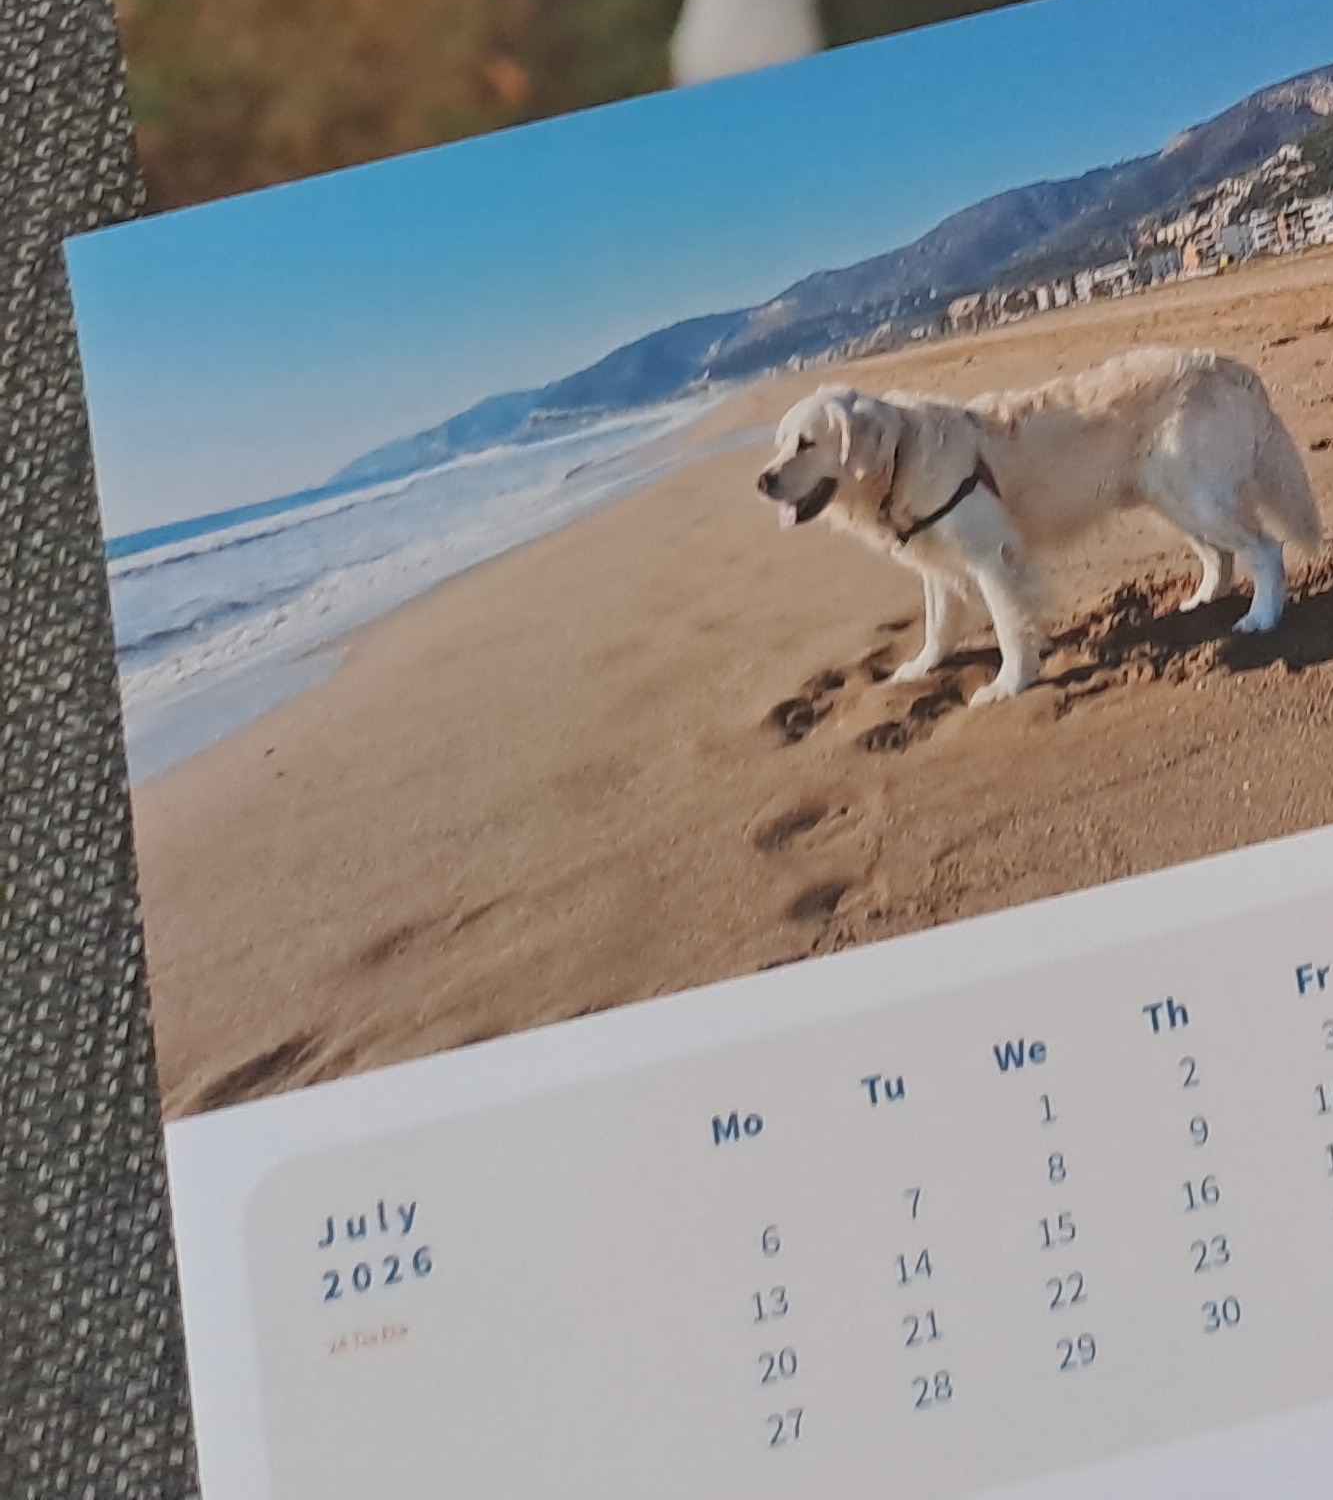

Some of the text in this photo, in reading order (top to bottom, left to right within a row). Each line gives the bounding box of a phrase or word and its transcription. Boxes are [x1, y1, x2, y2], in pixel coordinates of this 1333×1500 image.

[712, 963, 1329, 1146] Mo Tu We Th Fr
[319, 1200, 418, 1248] July
[323, 1246, 433, 1302] 2026
[753, 1287, 789, 1324] 13
[898, 1248, 932, 1285] 14
[1039, 1212, 1076, 1248] 15
[1183, 1175, 1220, 1211] 16
[758, 1348, 798, 1385] 20
[902, 1309, 938, 1347] 21
[1046, 1272, 1084, 1311] 22
[1190, 1235, 1231, 1274] 23
[767, 1408, 803, 1448] 27
[912, 1370, 953, 1409] 28
[1056, 1334, 1096, 1371] 29
[1202, 1296, 1241, 1330] 30
